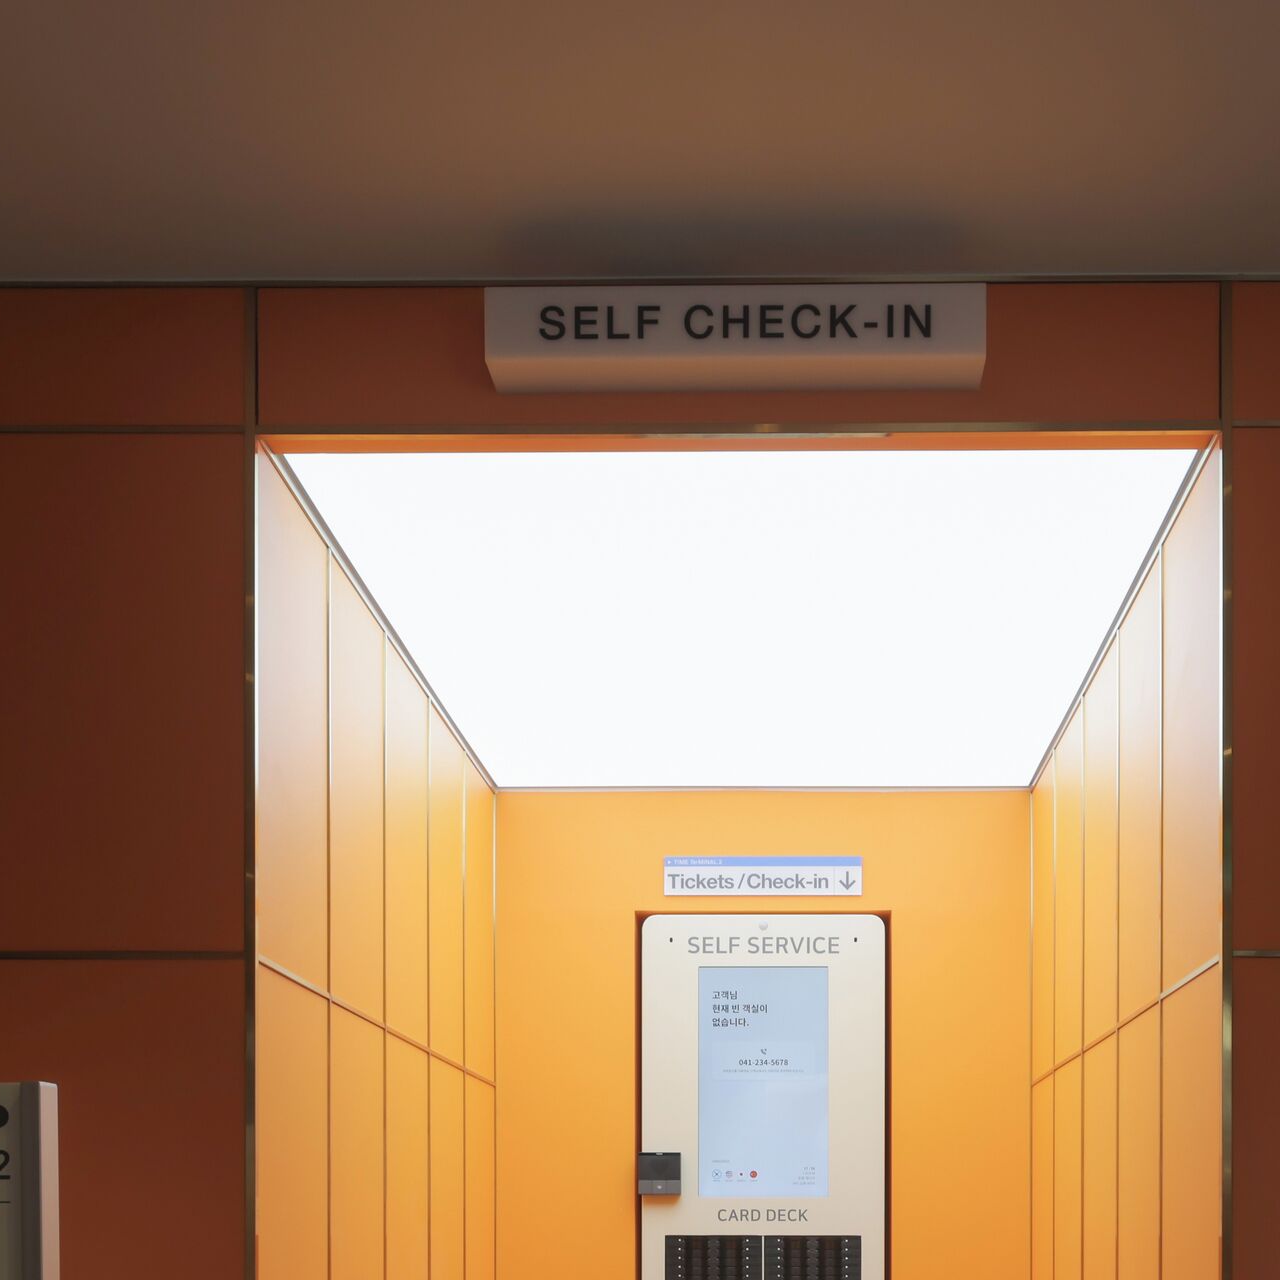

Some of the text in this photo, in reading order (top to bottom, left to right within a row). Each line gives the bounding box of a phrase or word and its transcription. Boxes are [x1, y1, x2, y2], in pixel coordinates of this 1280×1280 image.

[539, 304, 931, 341] SELF CHECK-IN
[688, 936, 840, 954] SELF SERVICE
[712, 990, 737, 1000] 고객님
[712, 1004, 767, 1014] 현재 빈 객실이
[712, 1017, 749, 1027] 없습니다.
[717, 1209, 808, 1222] CARD DECK
